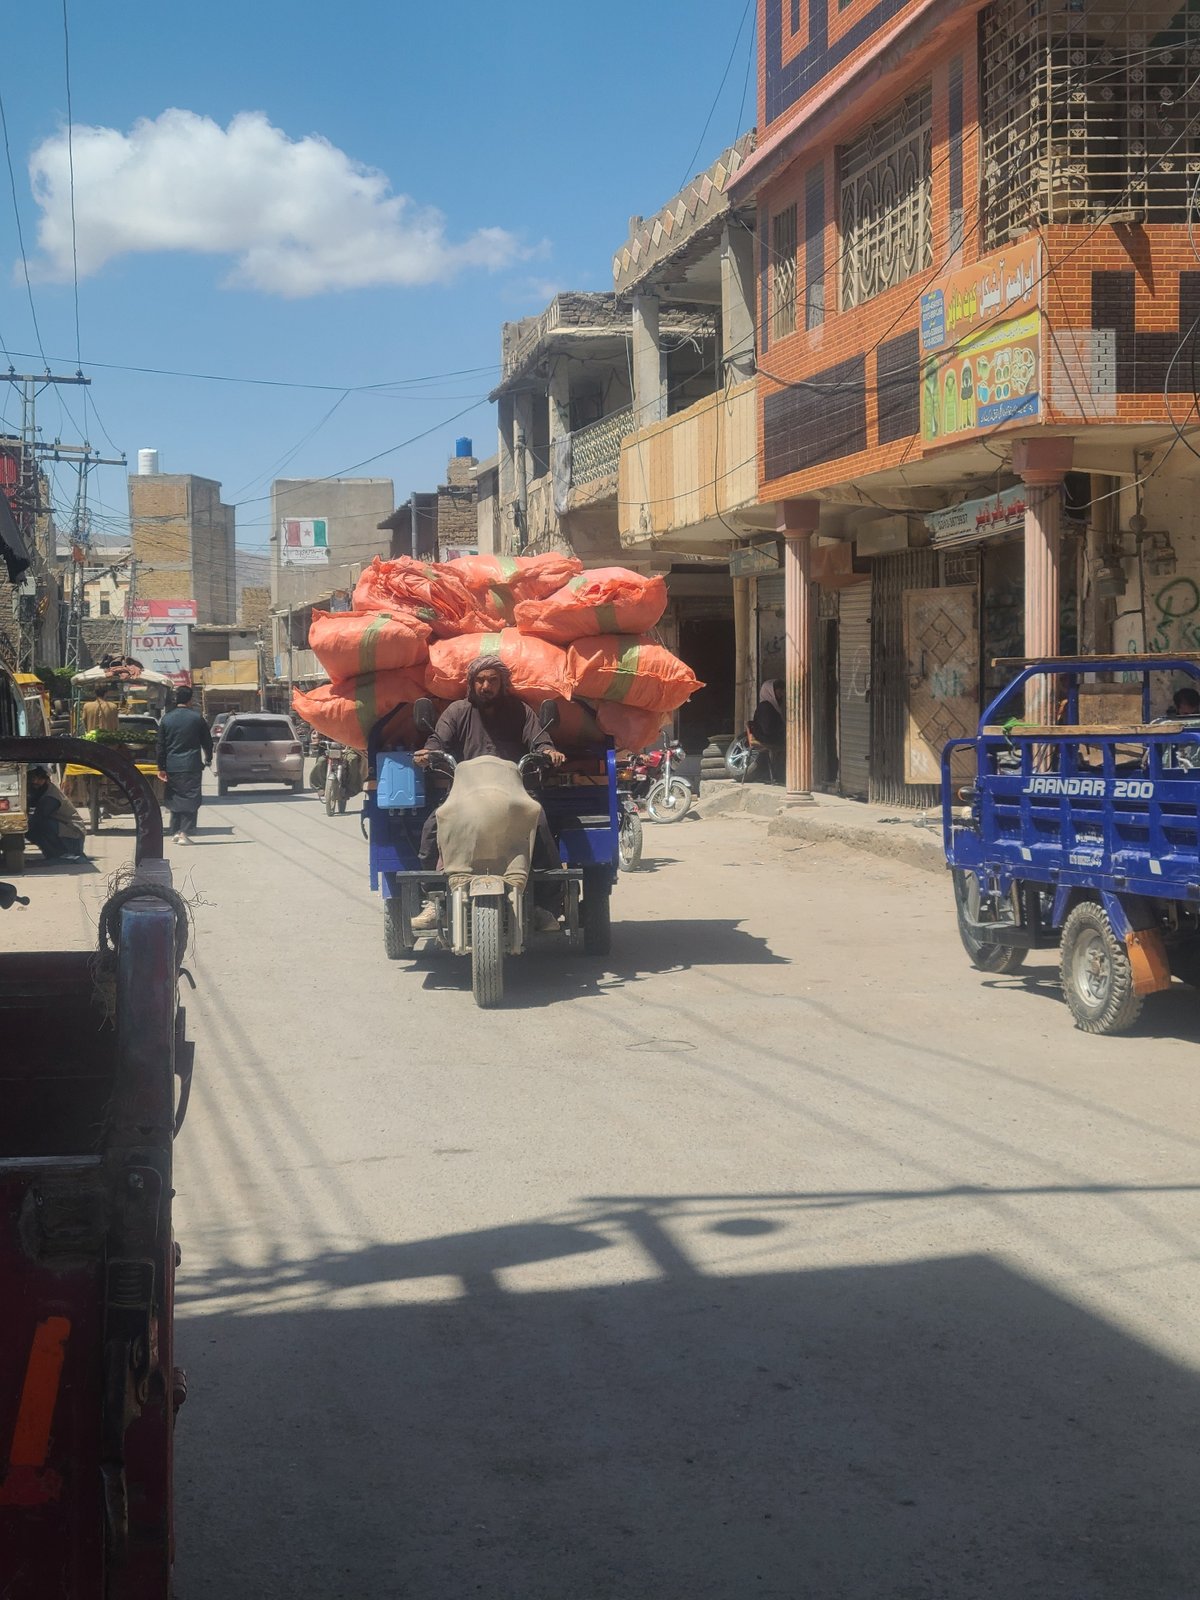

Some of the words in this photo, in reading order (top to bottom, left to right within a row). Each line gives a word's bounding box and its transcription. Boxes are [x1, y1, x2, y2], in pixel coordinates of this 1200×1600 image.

[132, 636, 183, 648] TOTAL
[1022, 778, 1106, 796] JAANDAR
[1113, 781, 1154, 799] 200
